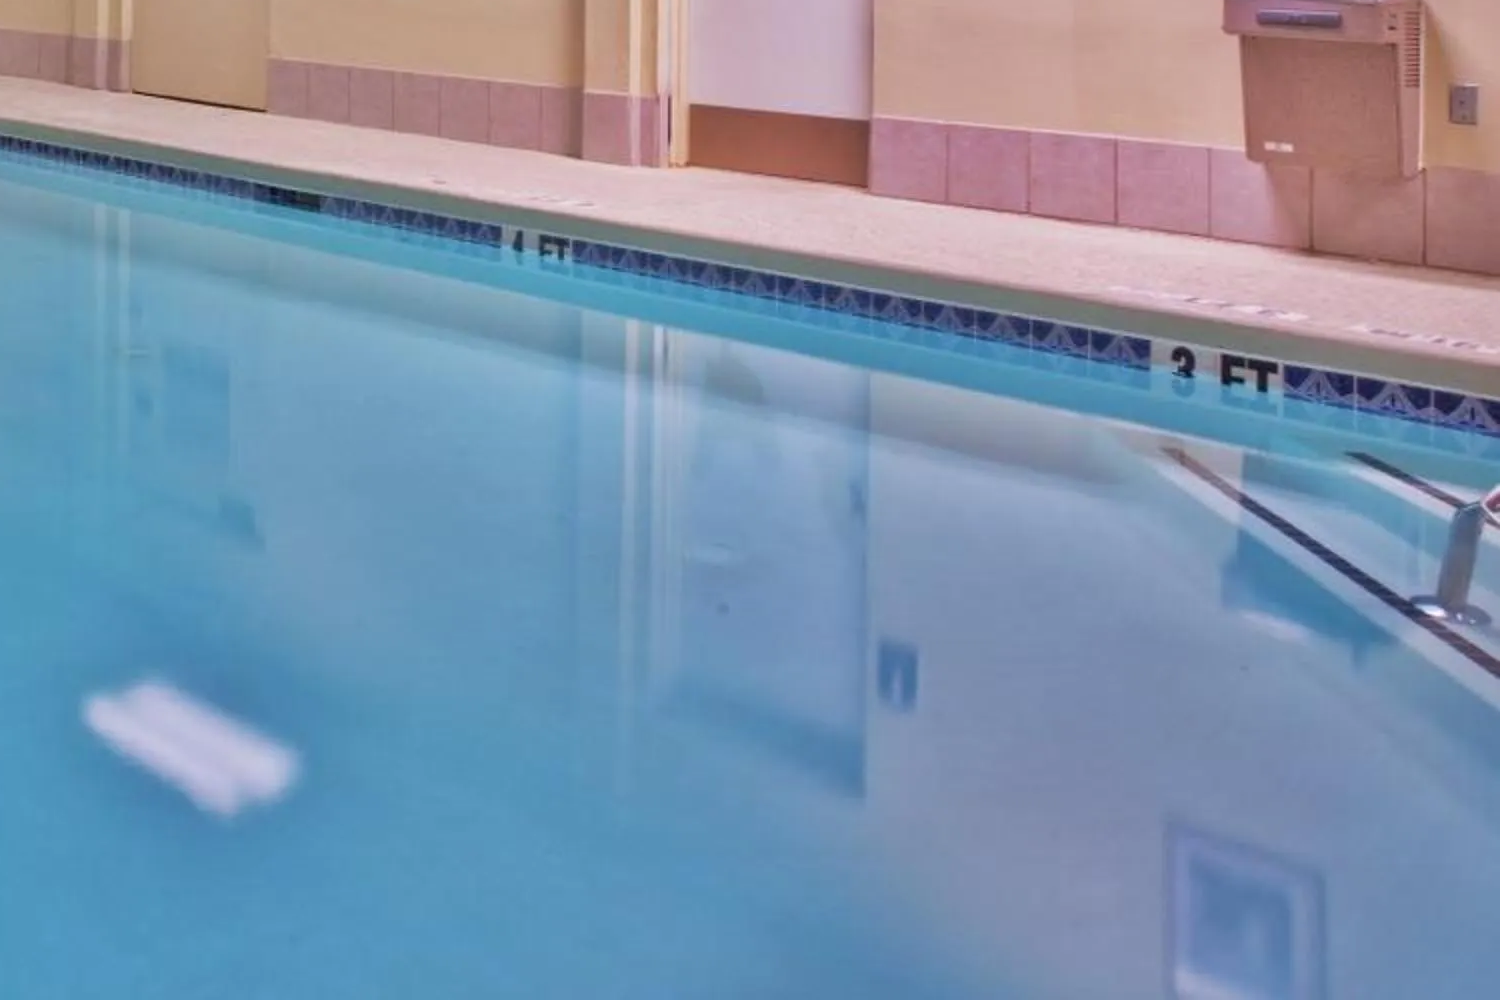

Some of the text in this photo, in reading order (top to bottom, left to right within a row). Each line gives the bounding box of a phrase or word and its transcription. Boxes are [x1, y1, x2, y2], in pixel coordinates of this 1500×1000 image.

[538, 234, 570, 261] FT
[1171, 346, 1278, 393] 3 FT
